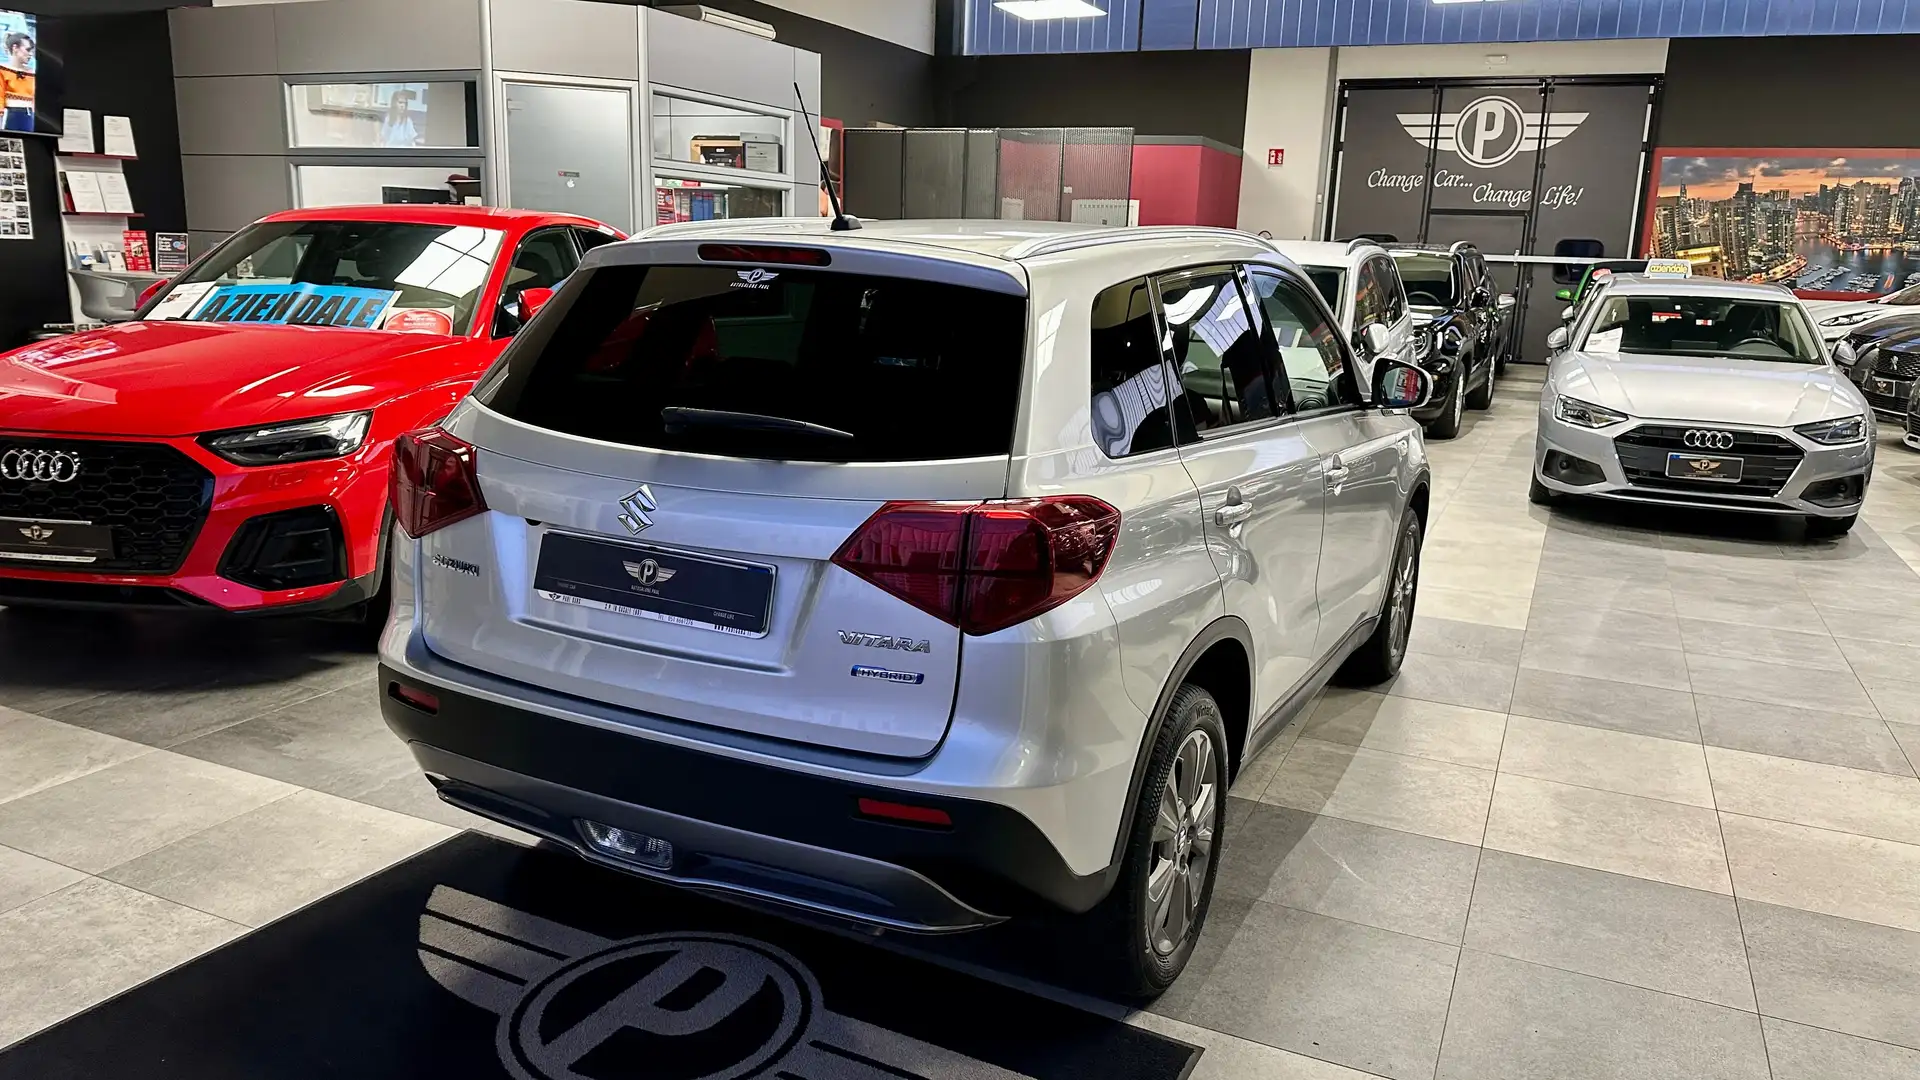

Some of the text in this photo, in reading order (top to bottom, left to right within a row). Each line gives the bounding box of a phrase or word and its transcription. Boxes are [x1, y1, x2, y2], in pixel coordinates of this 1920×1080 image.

[1367, 168, 1473, 193] Change Car...
[1472, 183, 1584, 210] Change Life!
[200, 290, 387, 328] AZIENDALE
[837, 629, 931, 654] VITARA
[861, 669, 913, 681] HYBRID
